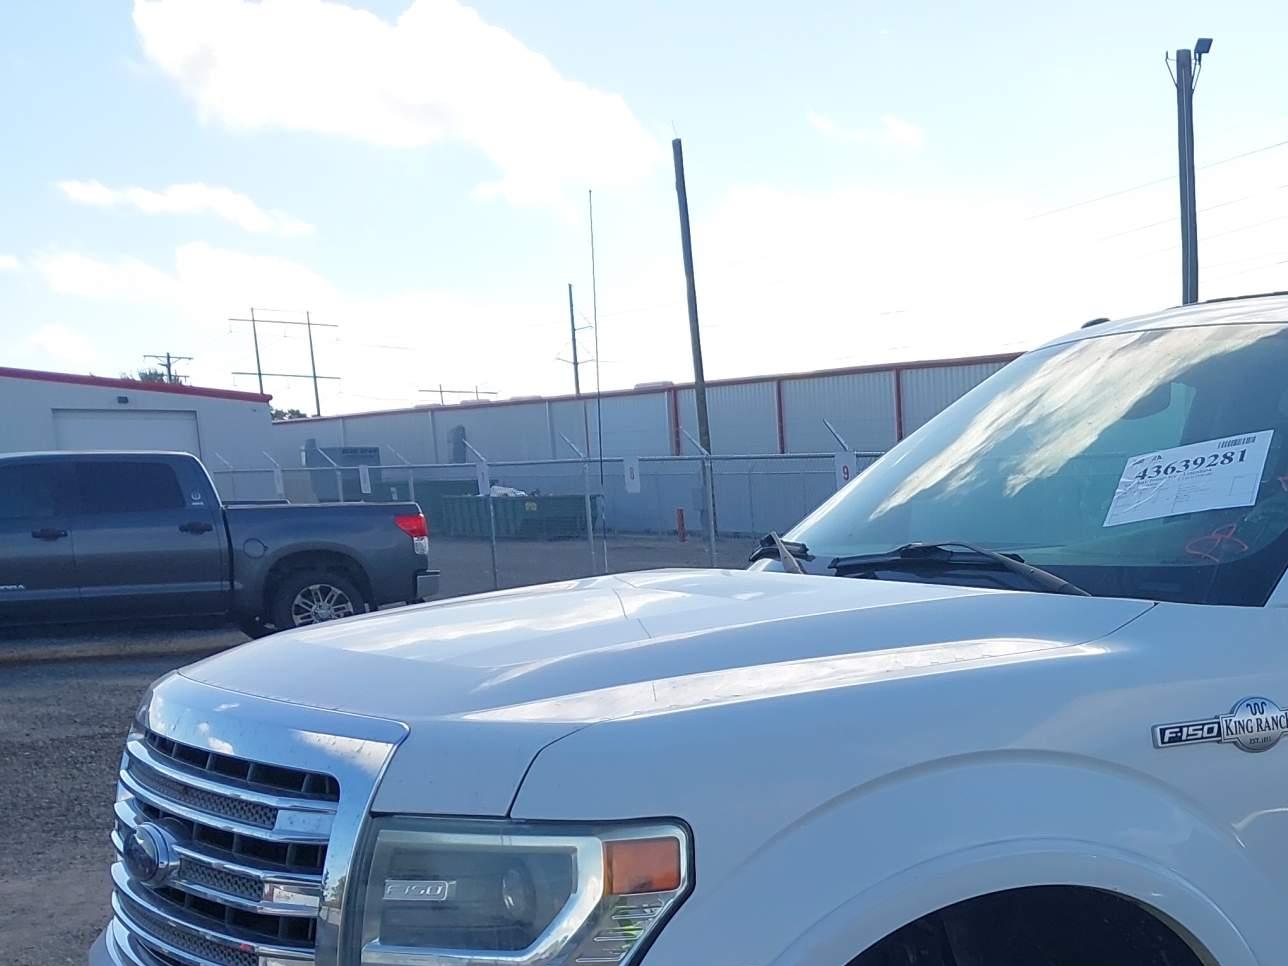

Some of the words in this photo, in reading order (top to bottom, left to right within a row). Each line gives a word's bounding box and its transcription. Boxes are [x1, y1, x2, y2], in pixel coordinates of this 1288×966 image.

[842, 465, 849, 480] 9
[1135, 449, 1247, 481] 43639281
[1164, 725, 1218, 742] F-150
[1225, 719, 1253, 736] KING
